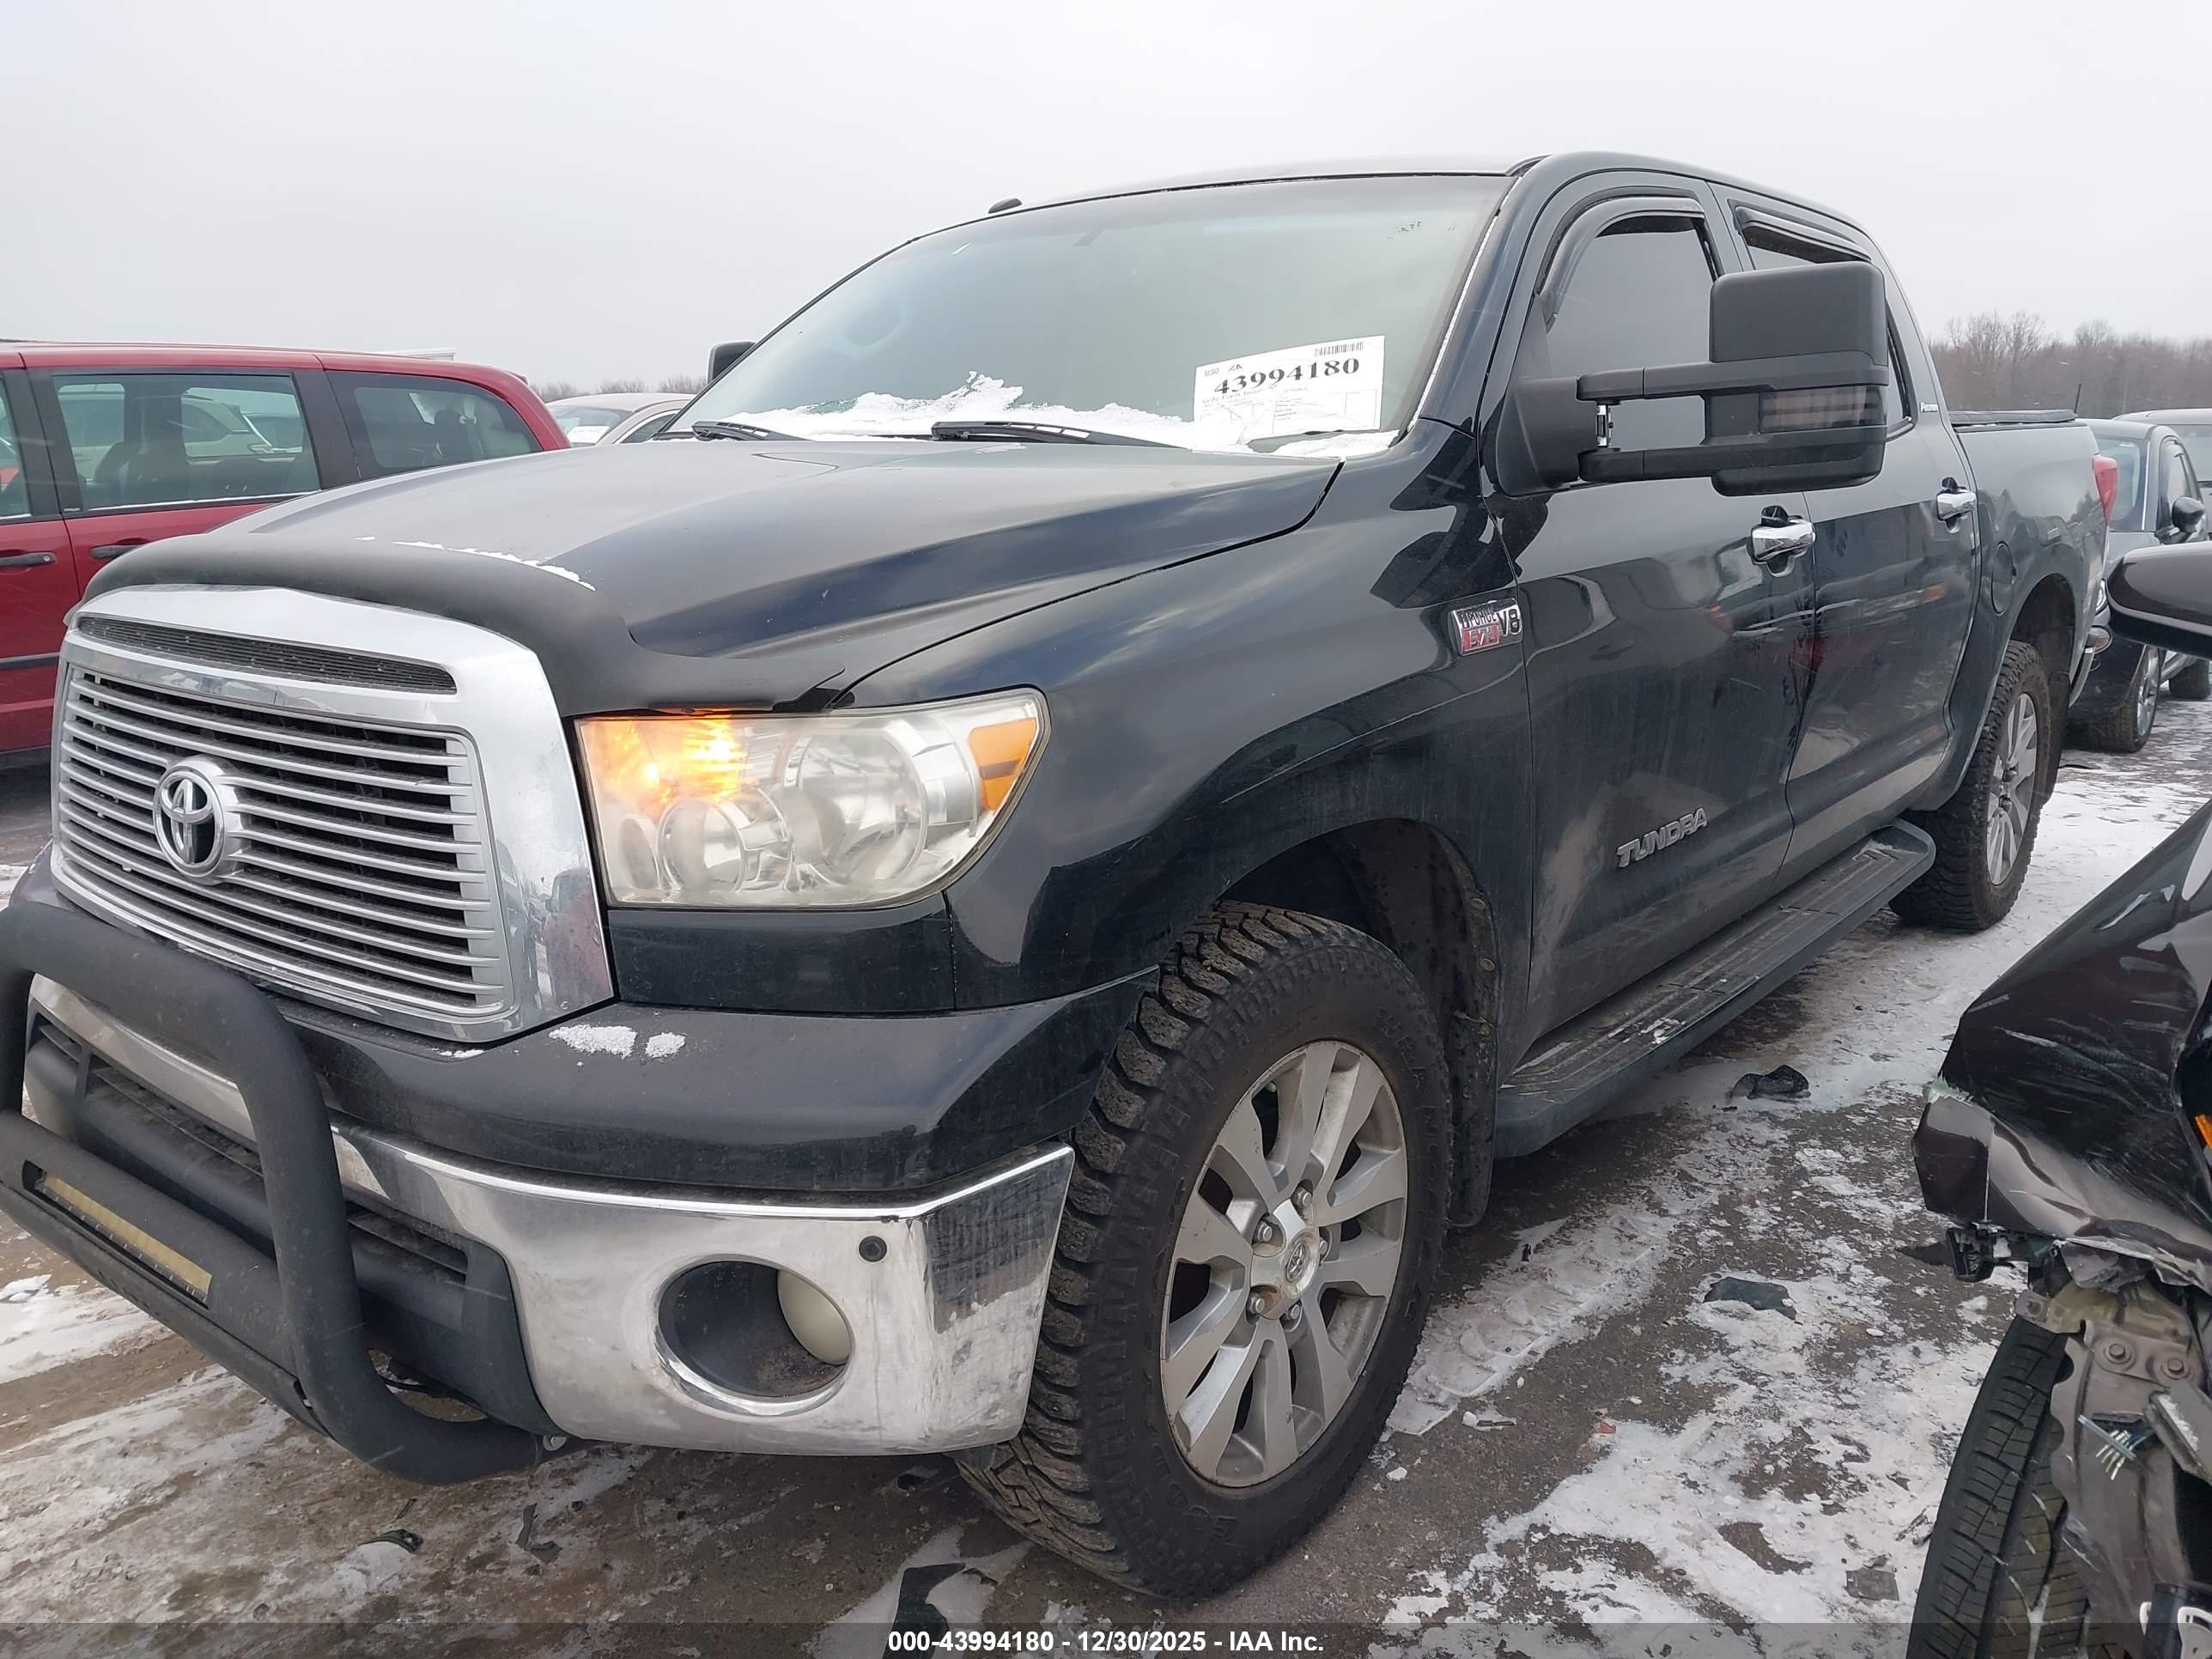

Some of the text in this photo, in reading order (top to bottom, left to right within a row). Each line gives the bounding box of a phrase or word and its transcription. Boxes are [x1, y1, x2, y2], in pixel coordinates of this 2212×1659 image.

[1214, 357, 1360, 394] 43994180
[1497, 608, 1522, 636] V8
[1616, 807, 1708, 868] TUNDRA
